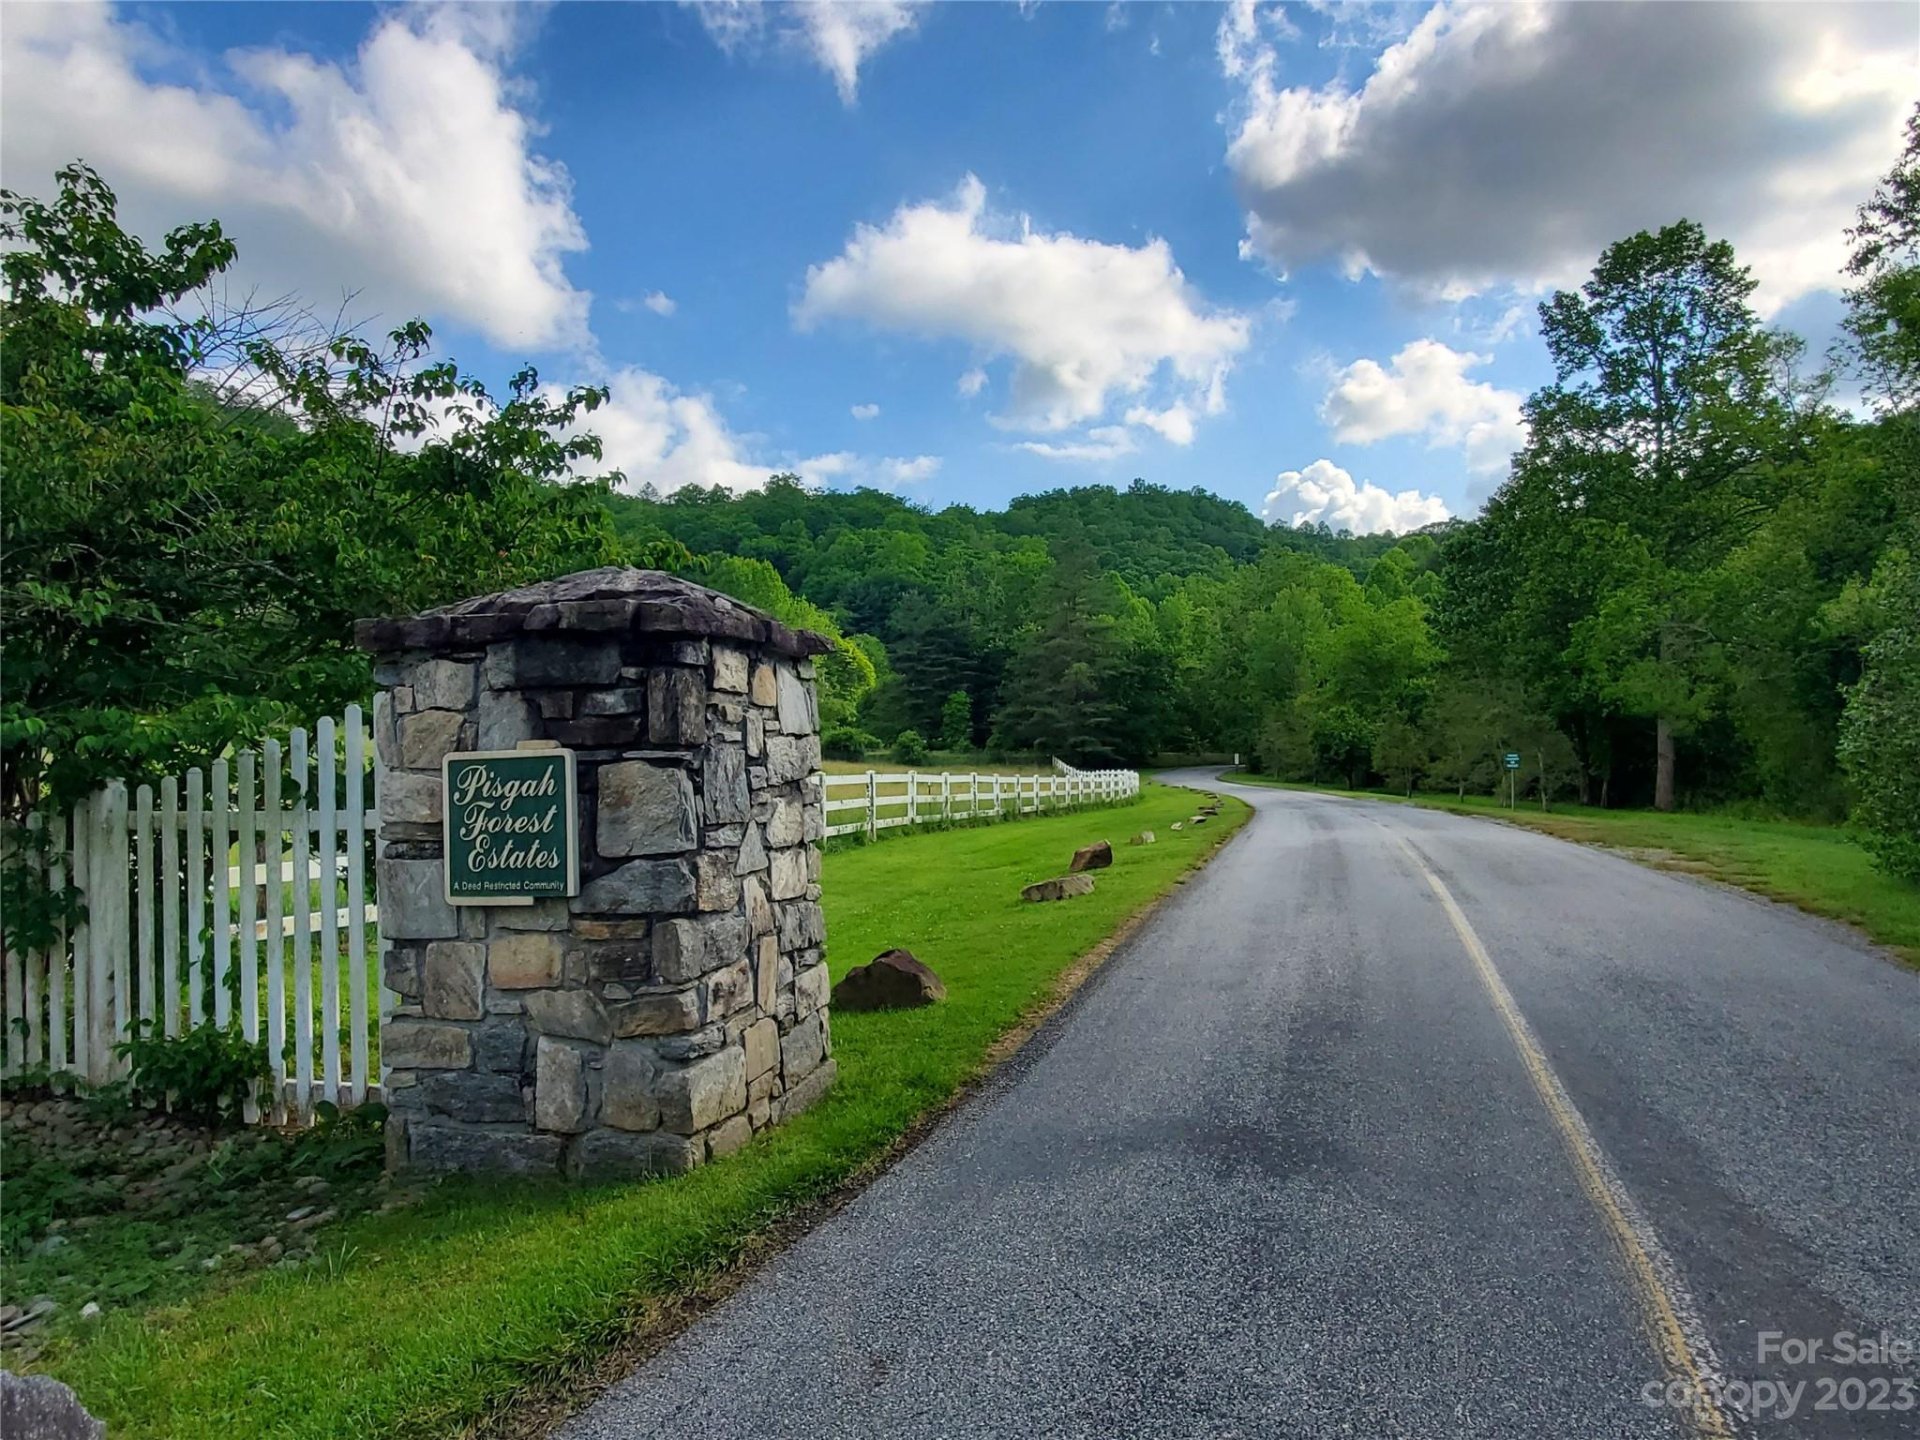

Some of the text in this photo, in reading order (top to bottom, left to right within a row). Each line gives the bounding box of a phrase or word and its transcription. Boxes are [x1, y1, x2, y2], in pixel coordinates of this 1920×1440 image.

[454, 765, 557, 810] Pisgah
[460, 801, 557, 841] Forest
[468, 834, 560, 872] Estates
[453, 880, 564, 891] A Deed Restricted Community
